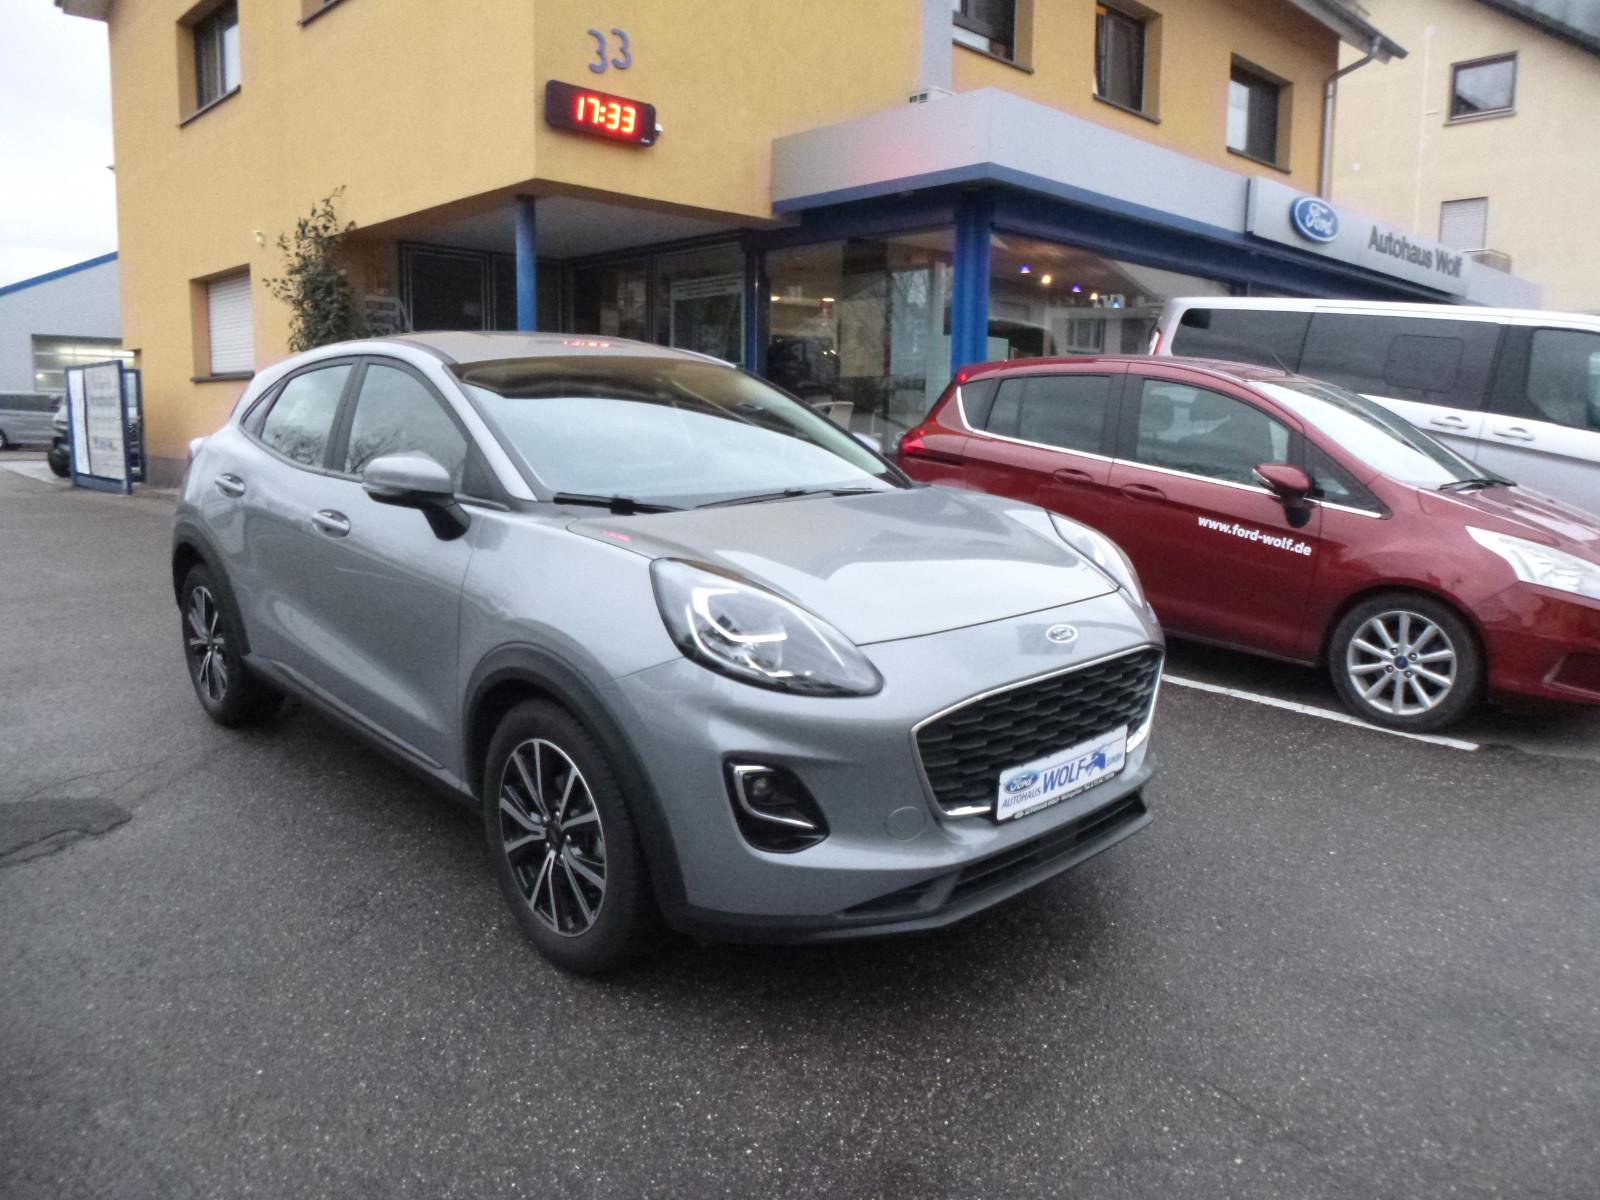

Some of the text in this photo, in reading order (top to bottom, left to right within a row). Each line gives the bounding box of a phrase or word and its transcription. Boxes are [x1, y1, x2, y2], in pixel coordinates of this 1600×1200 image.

[587, 28, 632, 73] 33
[577, 97, 636, 133] 17:33
[1304, 202, 1335, 235] Ford
[1368, 226, 1463, 278] Autohaus Wolf
[1198, 516, 1312, 556] www.ford-wolf.de
[1043, 758, 1087, 794] WOLF
[1002, 786, 1041, 808] AUTOHAUS
